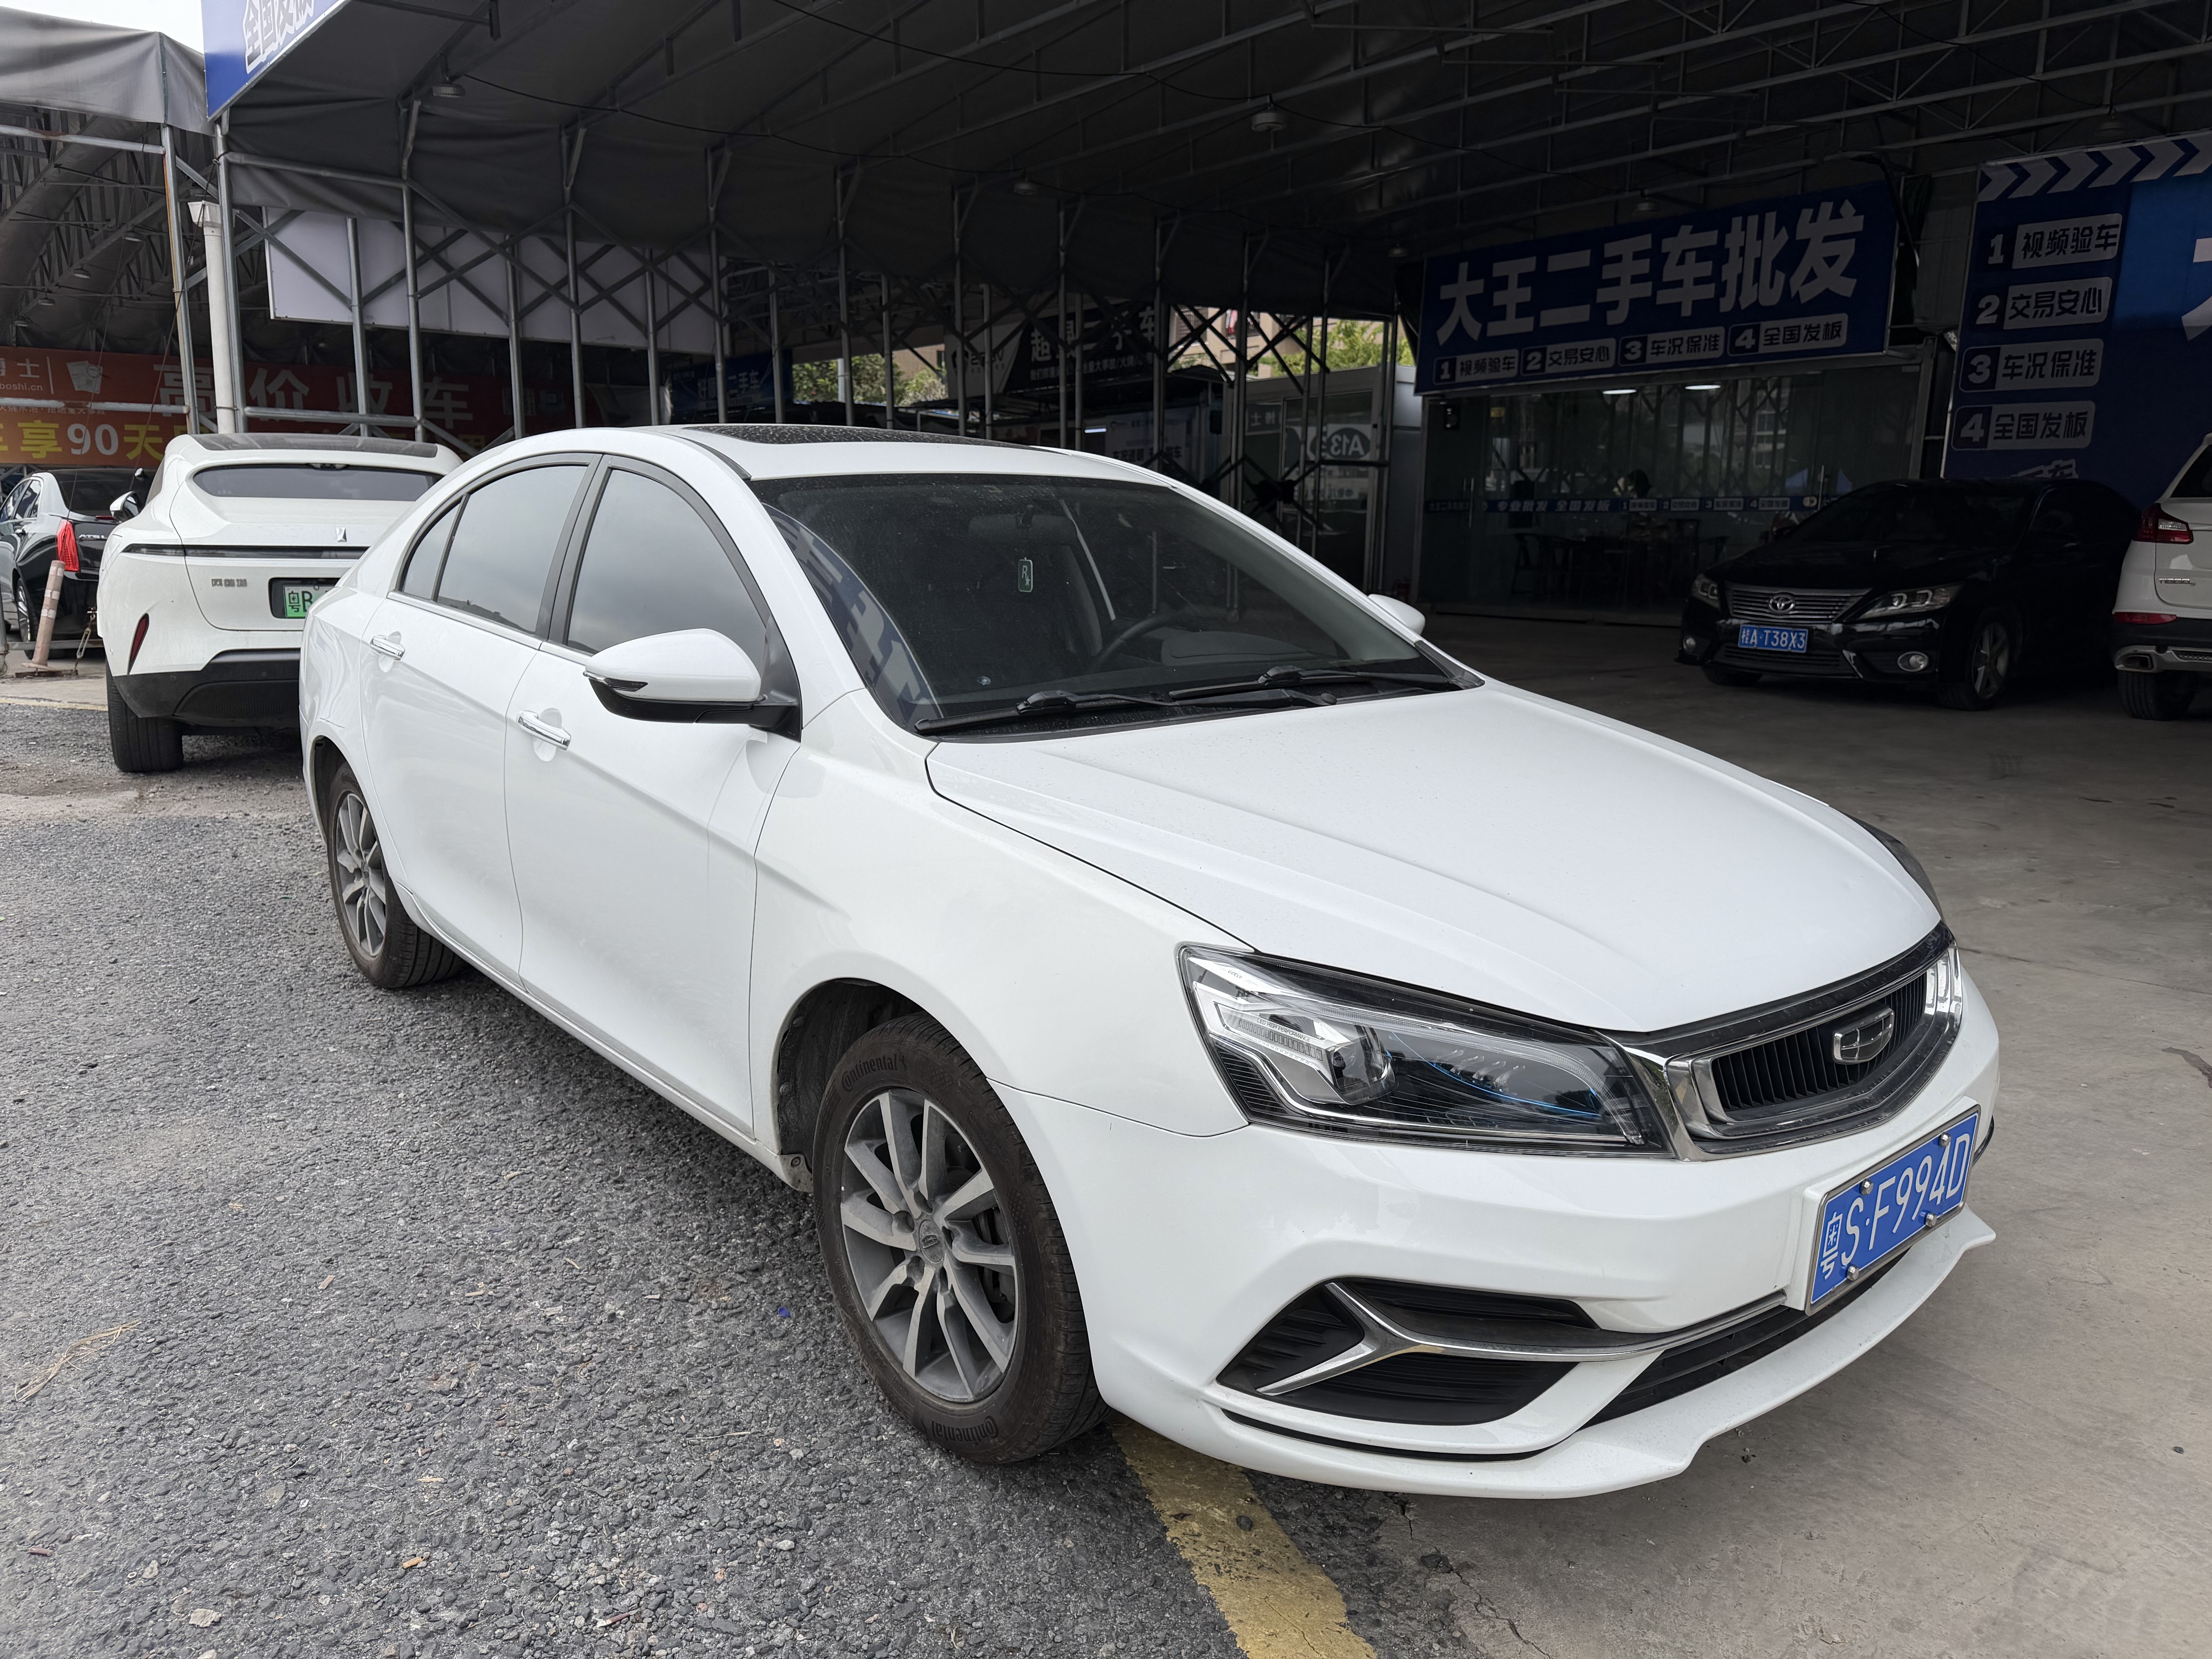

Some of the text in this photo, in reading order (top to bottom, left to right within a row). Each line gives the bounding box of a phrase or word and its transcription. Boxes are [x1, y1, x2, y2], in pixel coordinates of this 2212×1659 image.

[1987, 224, 2120, 265] 1 视频验车
[1436, 198, 1865, 346] 大王二手车批发
[1976, 287, 2102, 325] 2 交易安心
[0, 357, 40, 378] 士
[1440, 321, 1843, 379] 1 视频验车 2 交易安心 3 车况保准 4 全国发板
[1967, 349, 2096, 384] 3 车况保准
[153, 363, 474, 430] 高价收车
[1960, 411, 2088, 443] 4 全国发板
[288, 590, 328, 612] 粤B
[1278, 1023, 1311, 1042] PERFORMANCE
[842, 1053, 899, 1093] Continental
[931, 1415, 999, 1445] Continental
